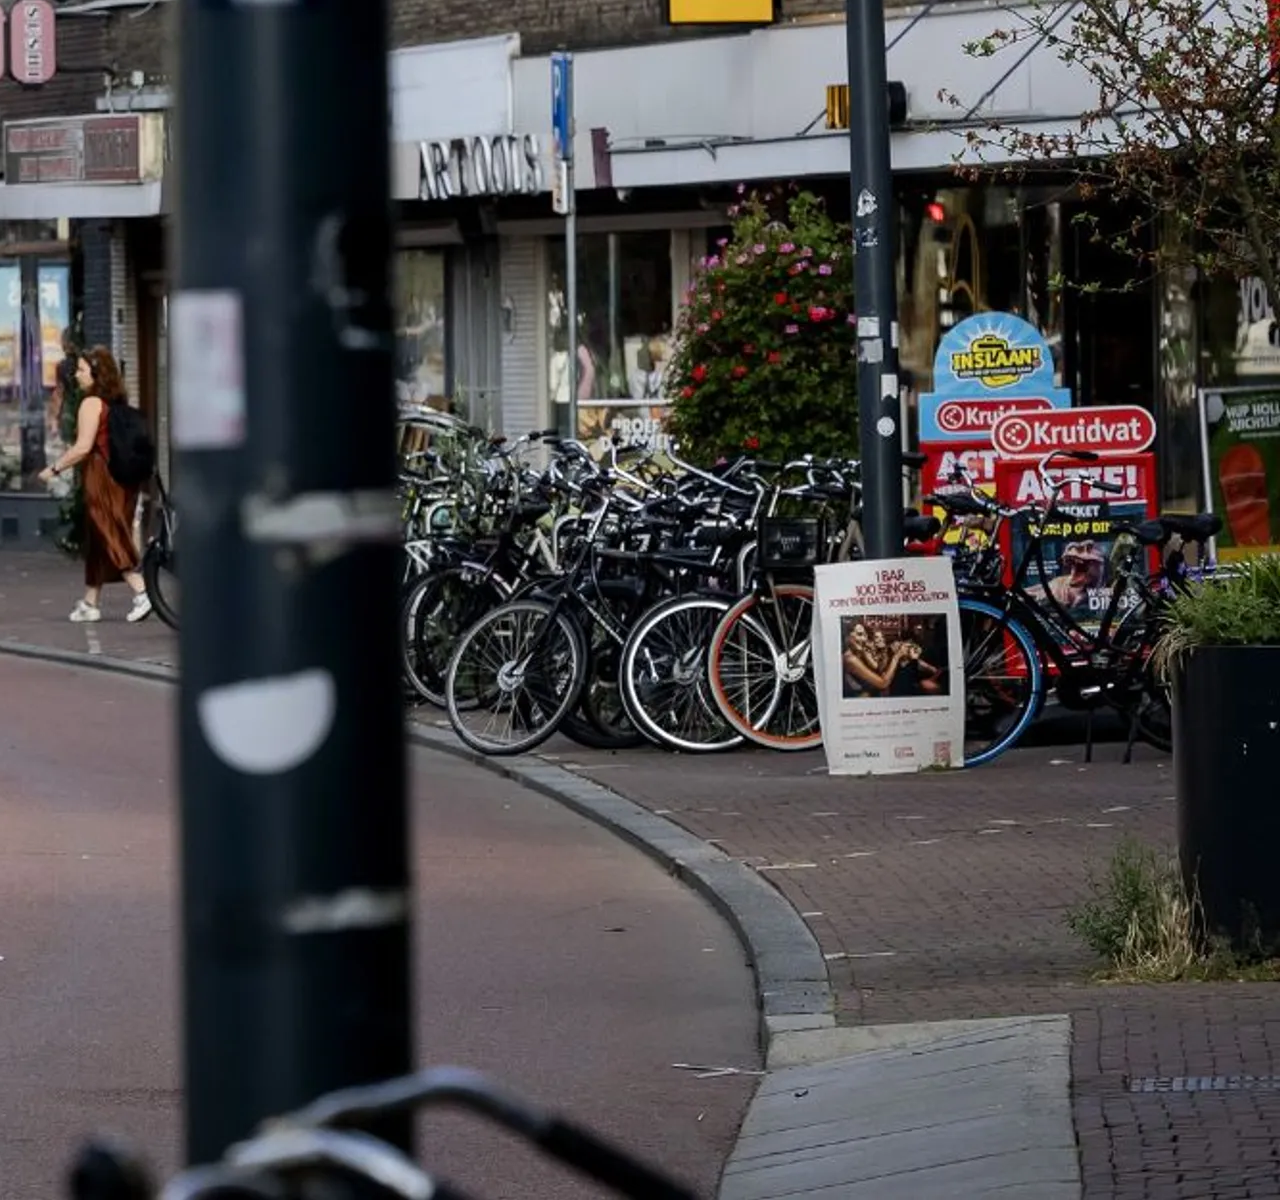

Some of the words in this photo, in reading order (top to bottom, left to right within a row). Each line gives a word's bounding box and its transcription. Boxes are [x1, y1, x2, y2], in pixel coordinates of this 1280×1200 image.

[953, 348, 1042, 370] INSLAAN!
[1034, 418, 1141, 445] Kruidvat
[881, 569, 905, 581] BAR
[855, 584, 877, 597] 100
[878, 580, 926, 595] SINGLES
